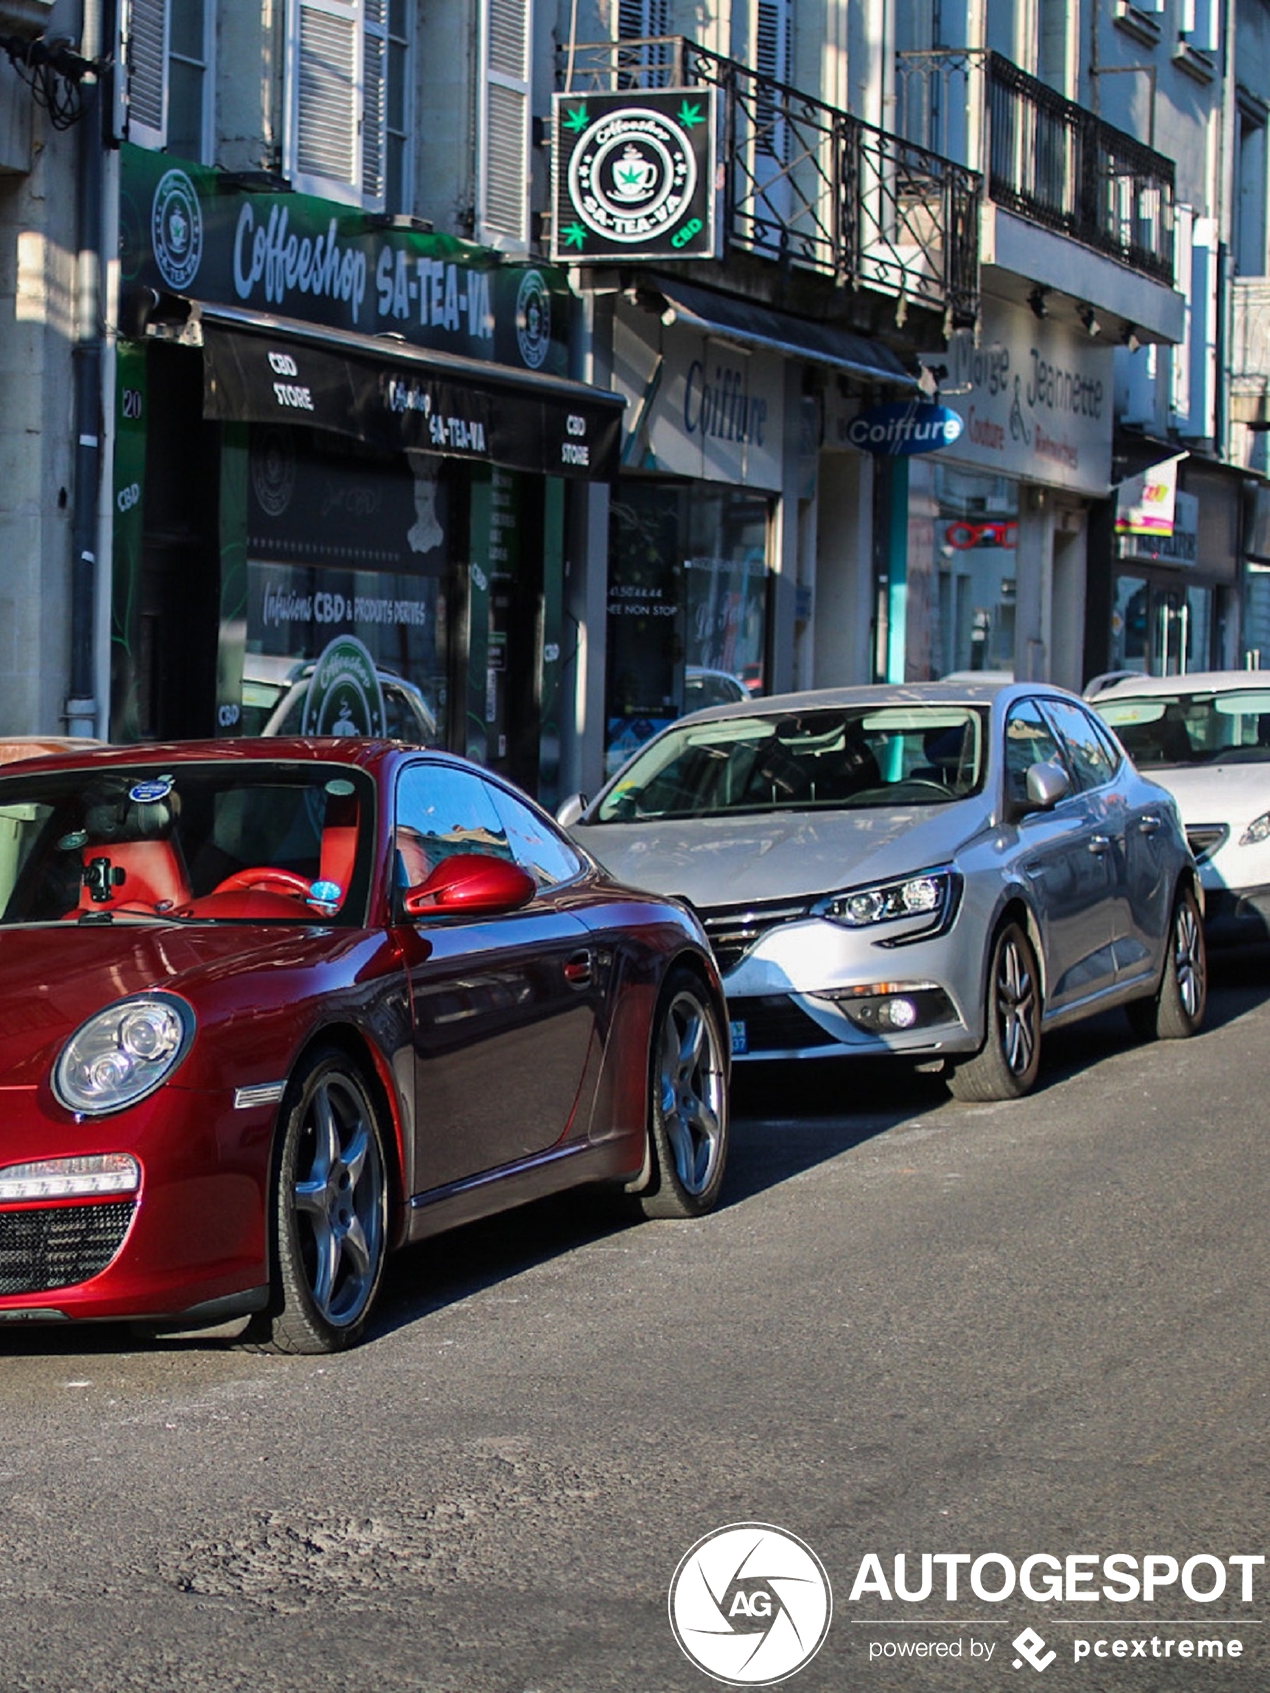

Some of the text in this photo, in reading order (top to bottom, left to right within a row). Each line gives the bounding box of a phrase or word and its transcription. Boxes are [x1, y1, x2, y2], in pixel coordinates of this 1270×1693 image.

[583, 195, 682, 233] SA-TEA-VA
[671, 218, 703, 248] CBD
[233, 201, 494, 338] Coffeeshop SA-TEA-VA
[268, 351, 297, 376] CBD
[274, 382, 314, 410] STORE
[1027, 348, 1103, 420] Jeannette
[684, 361, 768, 447] Coiffure
[430, 414, 485, 452] SA-TEA-VA
[566, 414, 586, 436] CBD
[849, 416, 961, 443] Coiffure
[562, 443, 589, 466] STORE
[117, 483, 140, 512] CBD
[263, 582, 312, 627] Infusions
[314, 592, 345, 624] CBD
[624, 604, 650, 616] NON
[653, 605, 679, 617] STOP
[218, 704, 240, 727] CBD
[732, 1036, 746, 1049] 37
